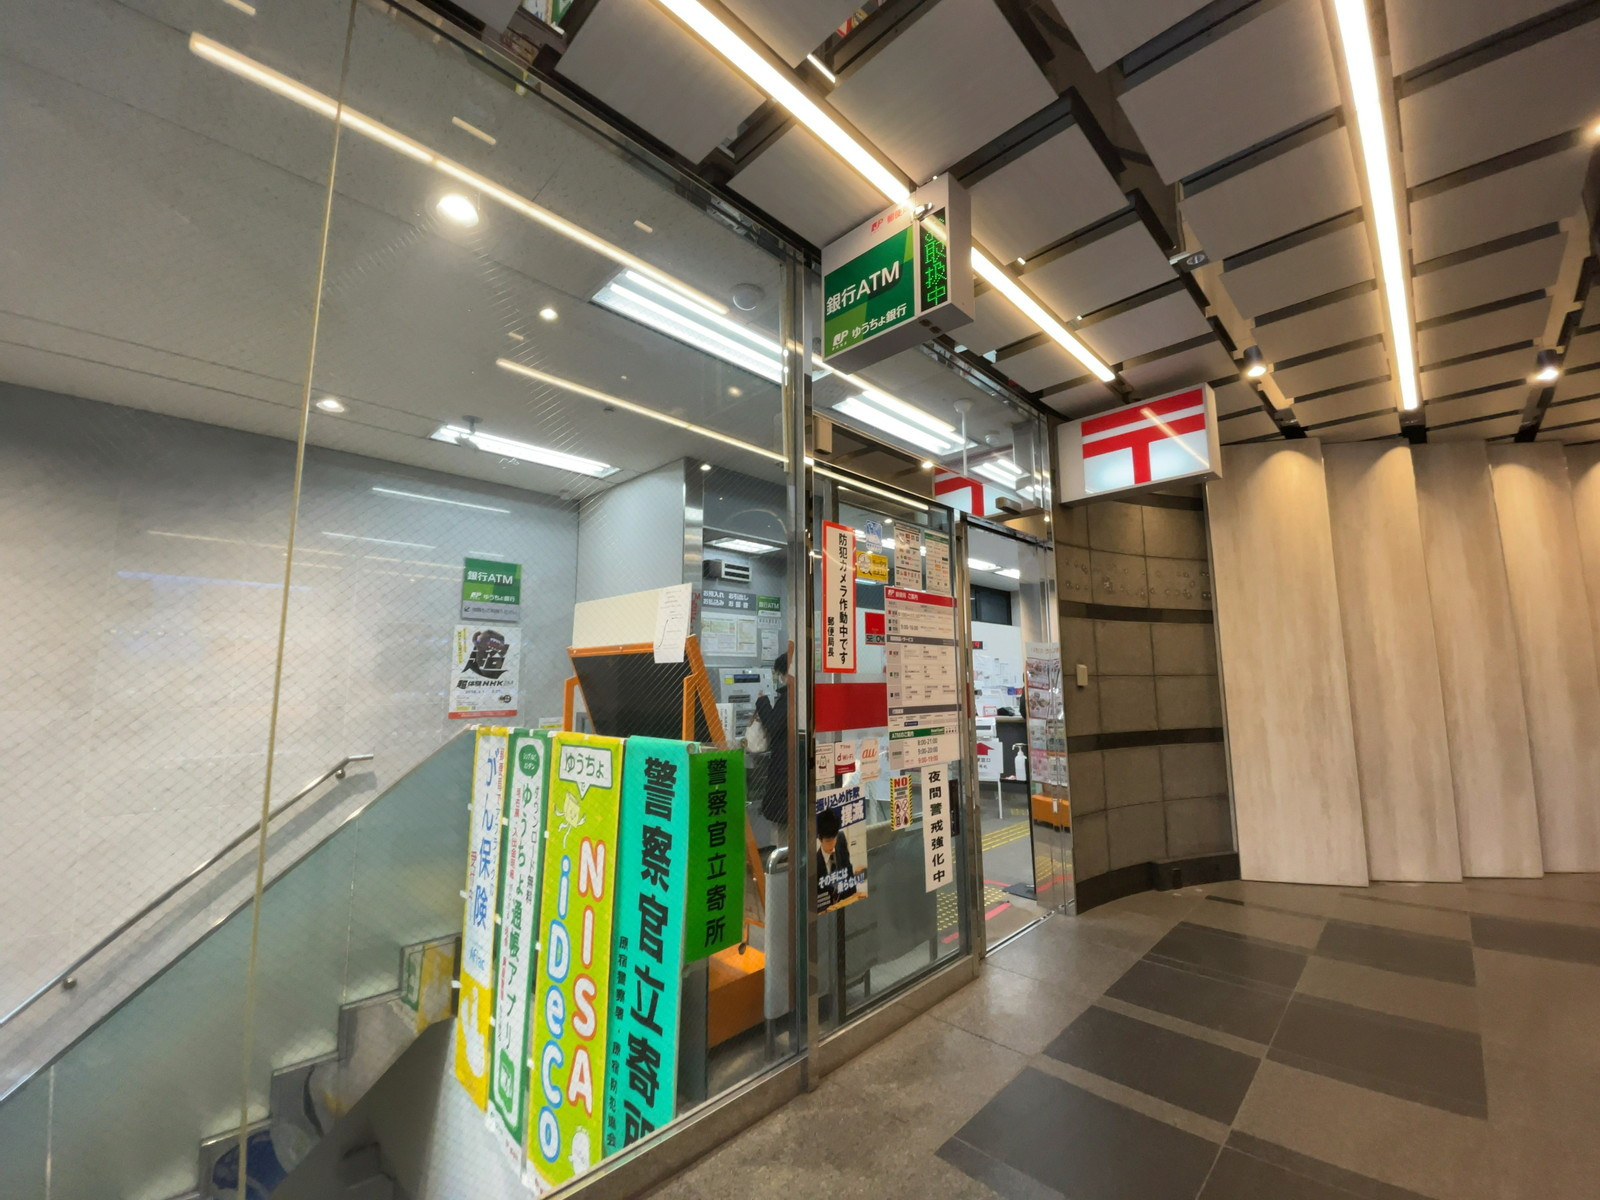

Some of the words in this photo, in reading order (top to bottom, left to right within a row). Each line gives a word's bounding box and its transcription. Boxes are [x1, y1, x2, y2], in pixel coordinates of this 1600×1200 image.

[826, 260, 900, 316] 銀行ATM
[852, 302, 907, 339] ゆうちょ銀行
[467, 570, 513, 585] 銀行ATM
[483, 593, 515, 603] ゆうちょ銀行
[838, 532, 848, 665] 防犯カメラ作動中です
[827, 616, 835, 658] 郵便局長
[565, 752, 605, 779] ゆうちょ
[893, 776, 908, 788] NO
[928, 770, 946, 884] 夜間警戒強化中
[703, 758, 728, 948] 警察官立寄所
[818, 866, 849, 890] その手には
[504, 783, 534, 1050] ゆうちょ通帳アプリ
[566, 836, 606, 1118] NISA
[538, 854, 572, 1163] iDeCo
